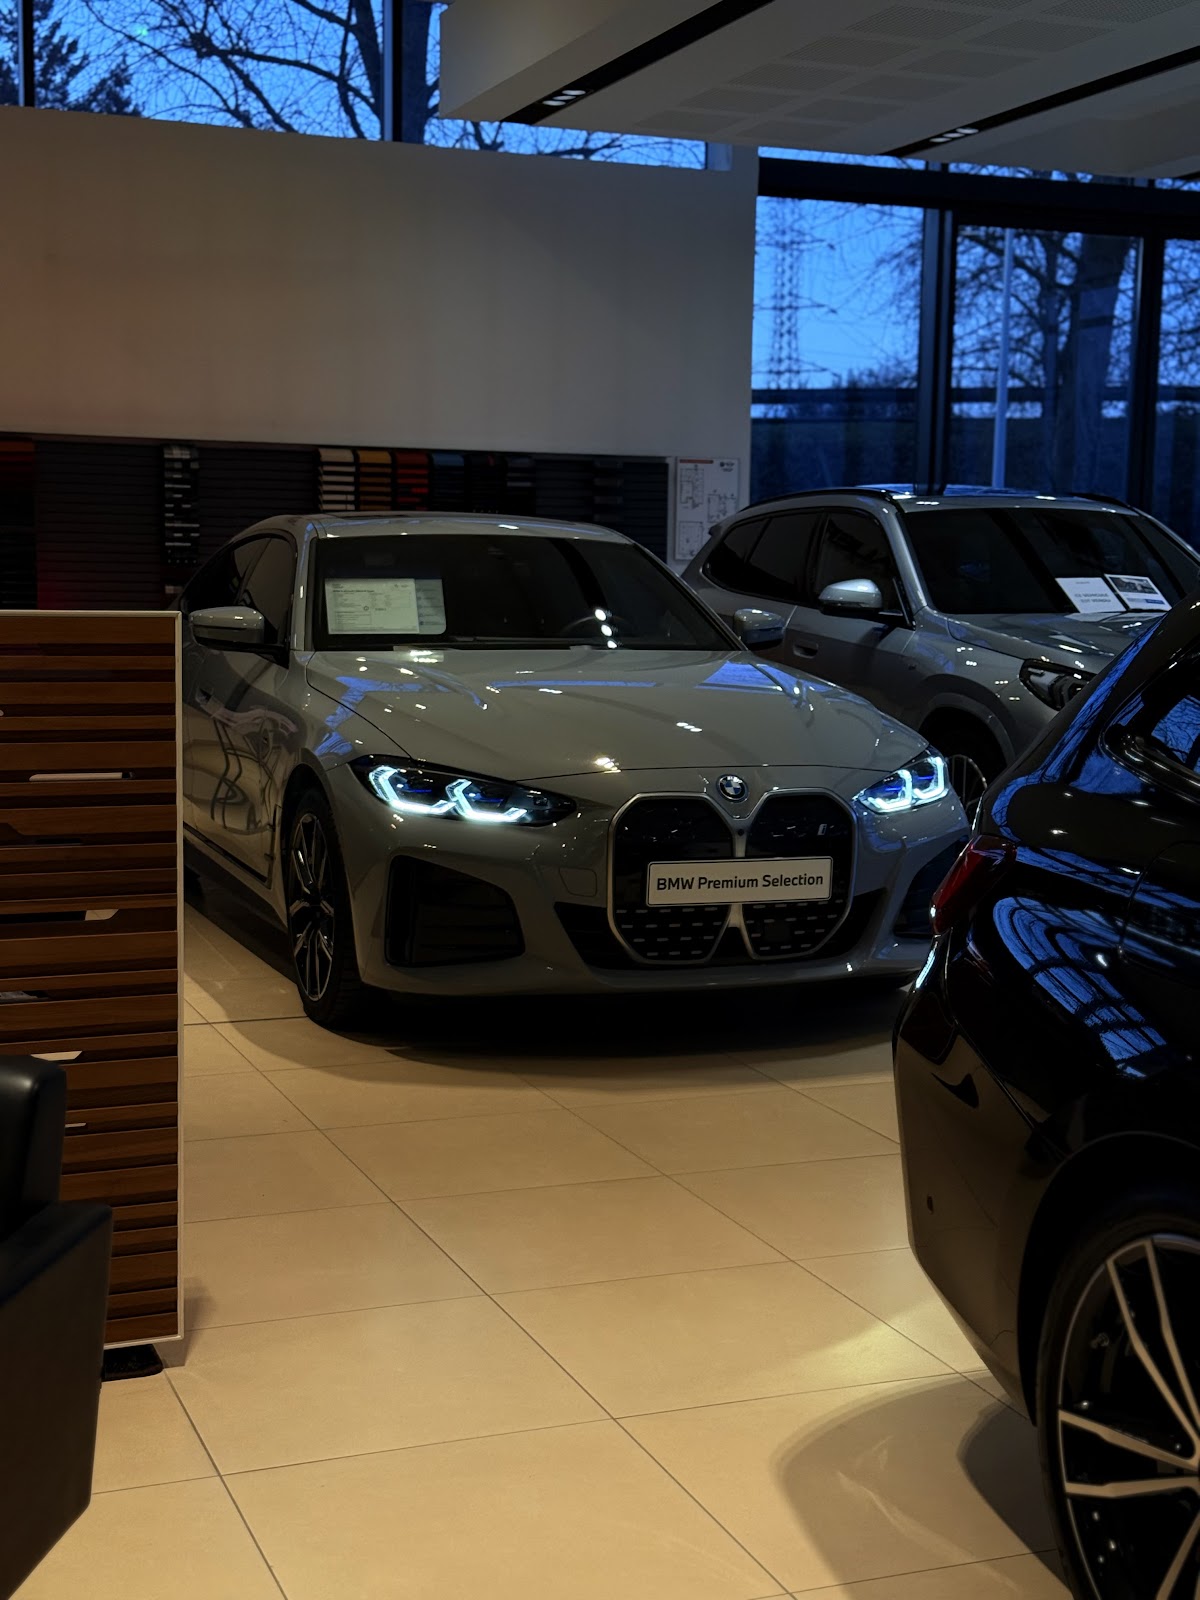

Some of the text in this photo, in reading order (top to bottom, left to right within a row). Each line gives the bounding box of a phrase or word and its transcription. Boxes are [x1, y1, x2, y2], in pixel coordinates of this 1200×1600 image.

[656, 873, 824, 890] BMW Premium Selection
